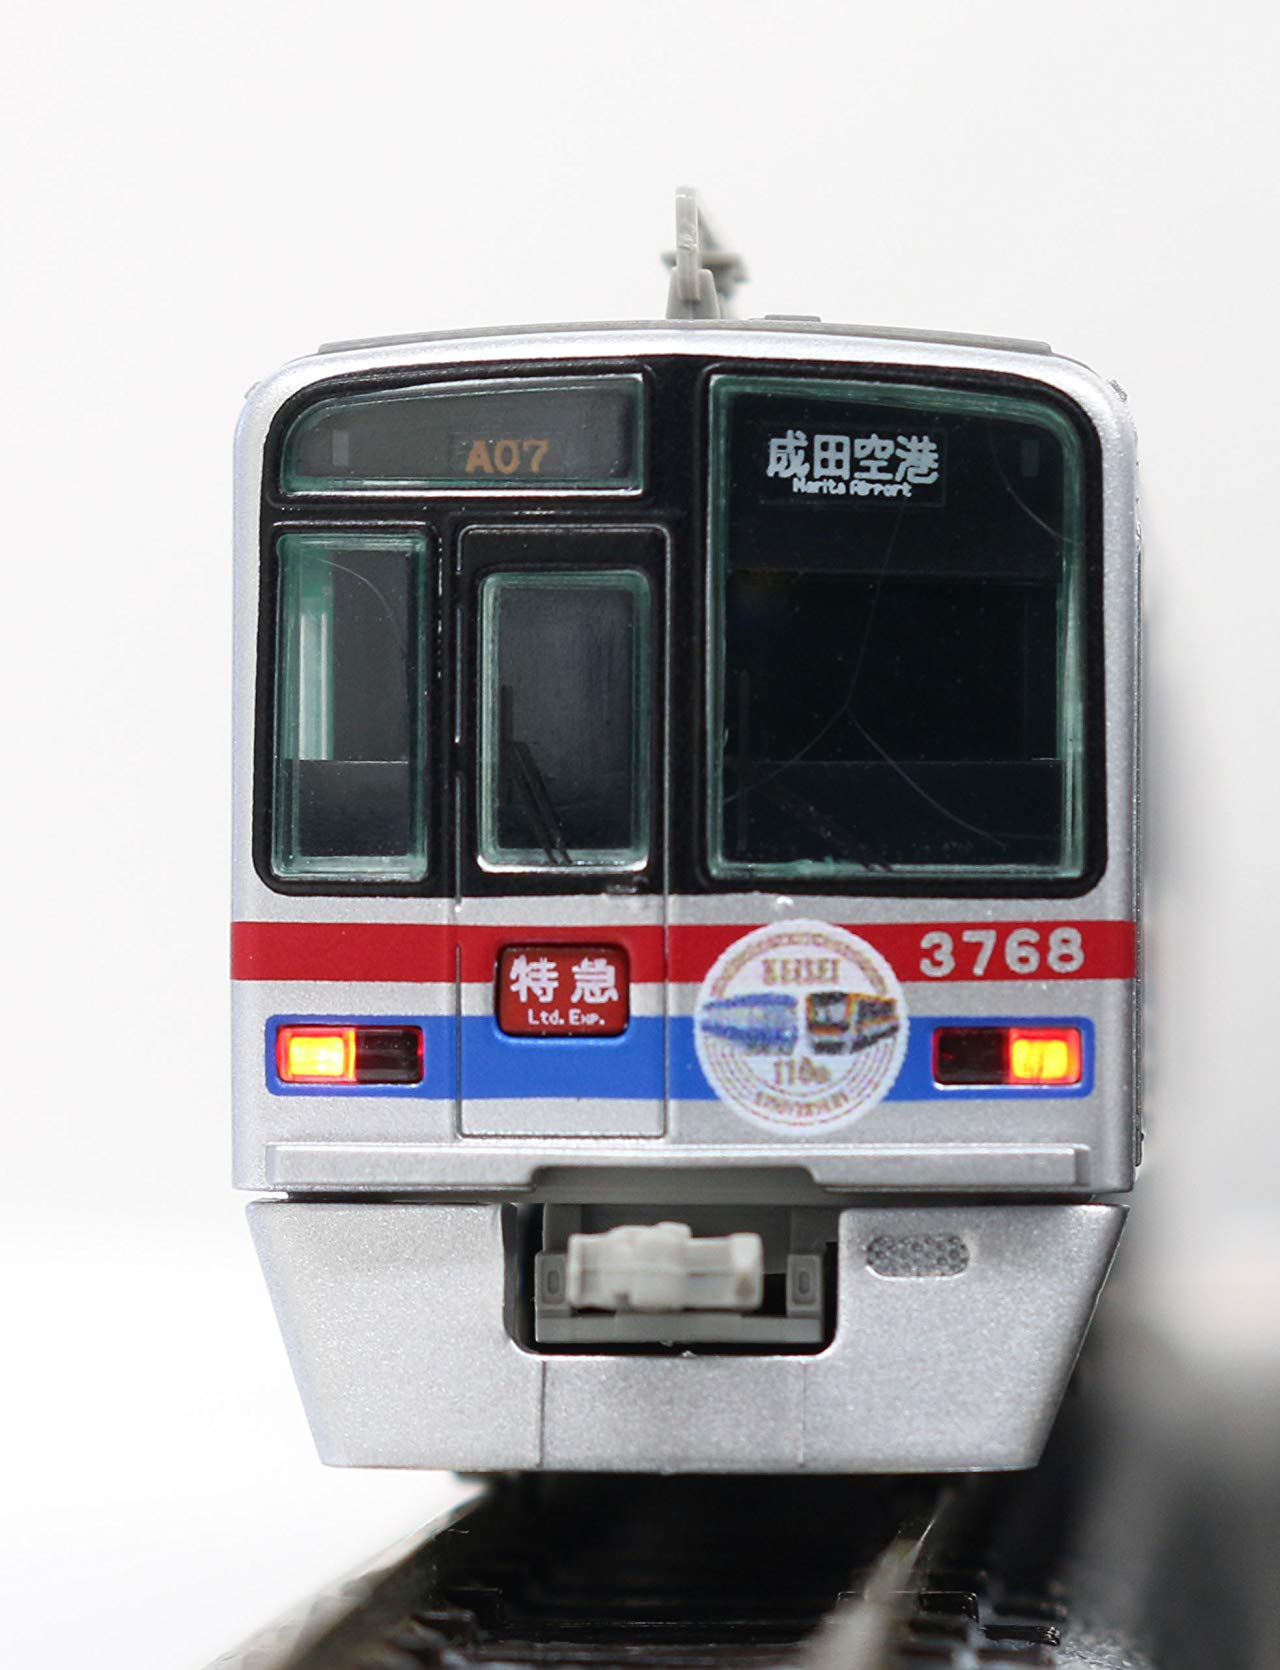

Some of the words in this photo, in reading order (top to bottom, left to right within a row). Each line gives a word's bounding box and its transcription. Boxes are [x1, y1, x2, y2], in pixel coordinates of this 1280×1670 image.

[465, 438, 549, 474] A07
[767, 429, 939, 484] 成田空港
[762, 957, 840, 986] KEISEI
[920, 926, 1085, 978] 3768
[510, 954, 619, 1004] 特急
[528, 1008, 565, 1025] Ltd.
